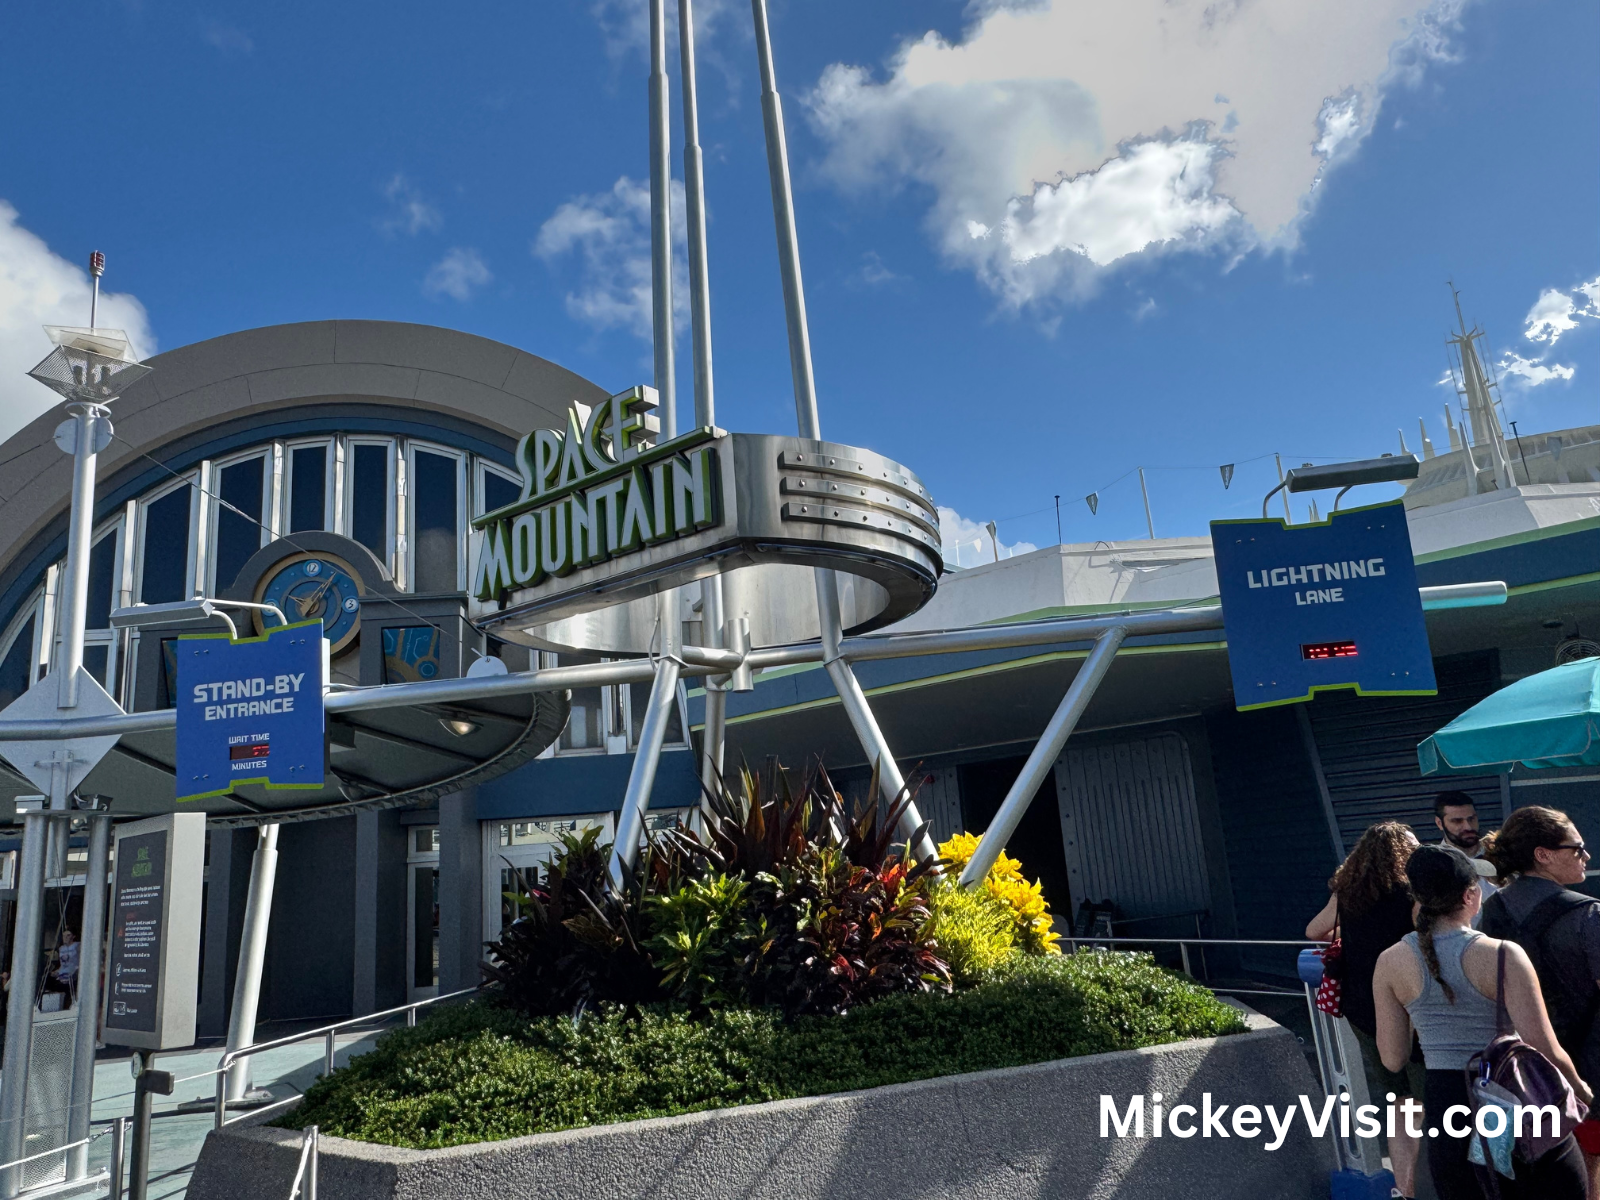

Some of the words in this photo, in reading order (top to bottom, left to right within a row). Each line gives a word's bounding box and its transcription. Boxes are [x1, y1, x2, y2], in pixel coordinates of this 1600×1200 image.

[515, 385, 660, 503] SPACE
[473, 447, 717, 602] MOUNTAIN
[1247, 558, 1385, 588] LIGHTNING
[1295, 588, 1344, 605] LANE
[193, 673, 305, 703] STAND-BY
[205, 697, 294, 720] ENTRANCE
[228, 735, 249, 744] WAIT
[250, 733, 270, 742] TIME
[231, 760, 267, 771] MINUTES
